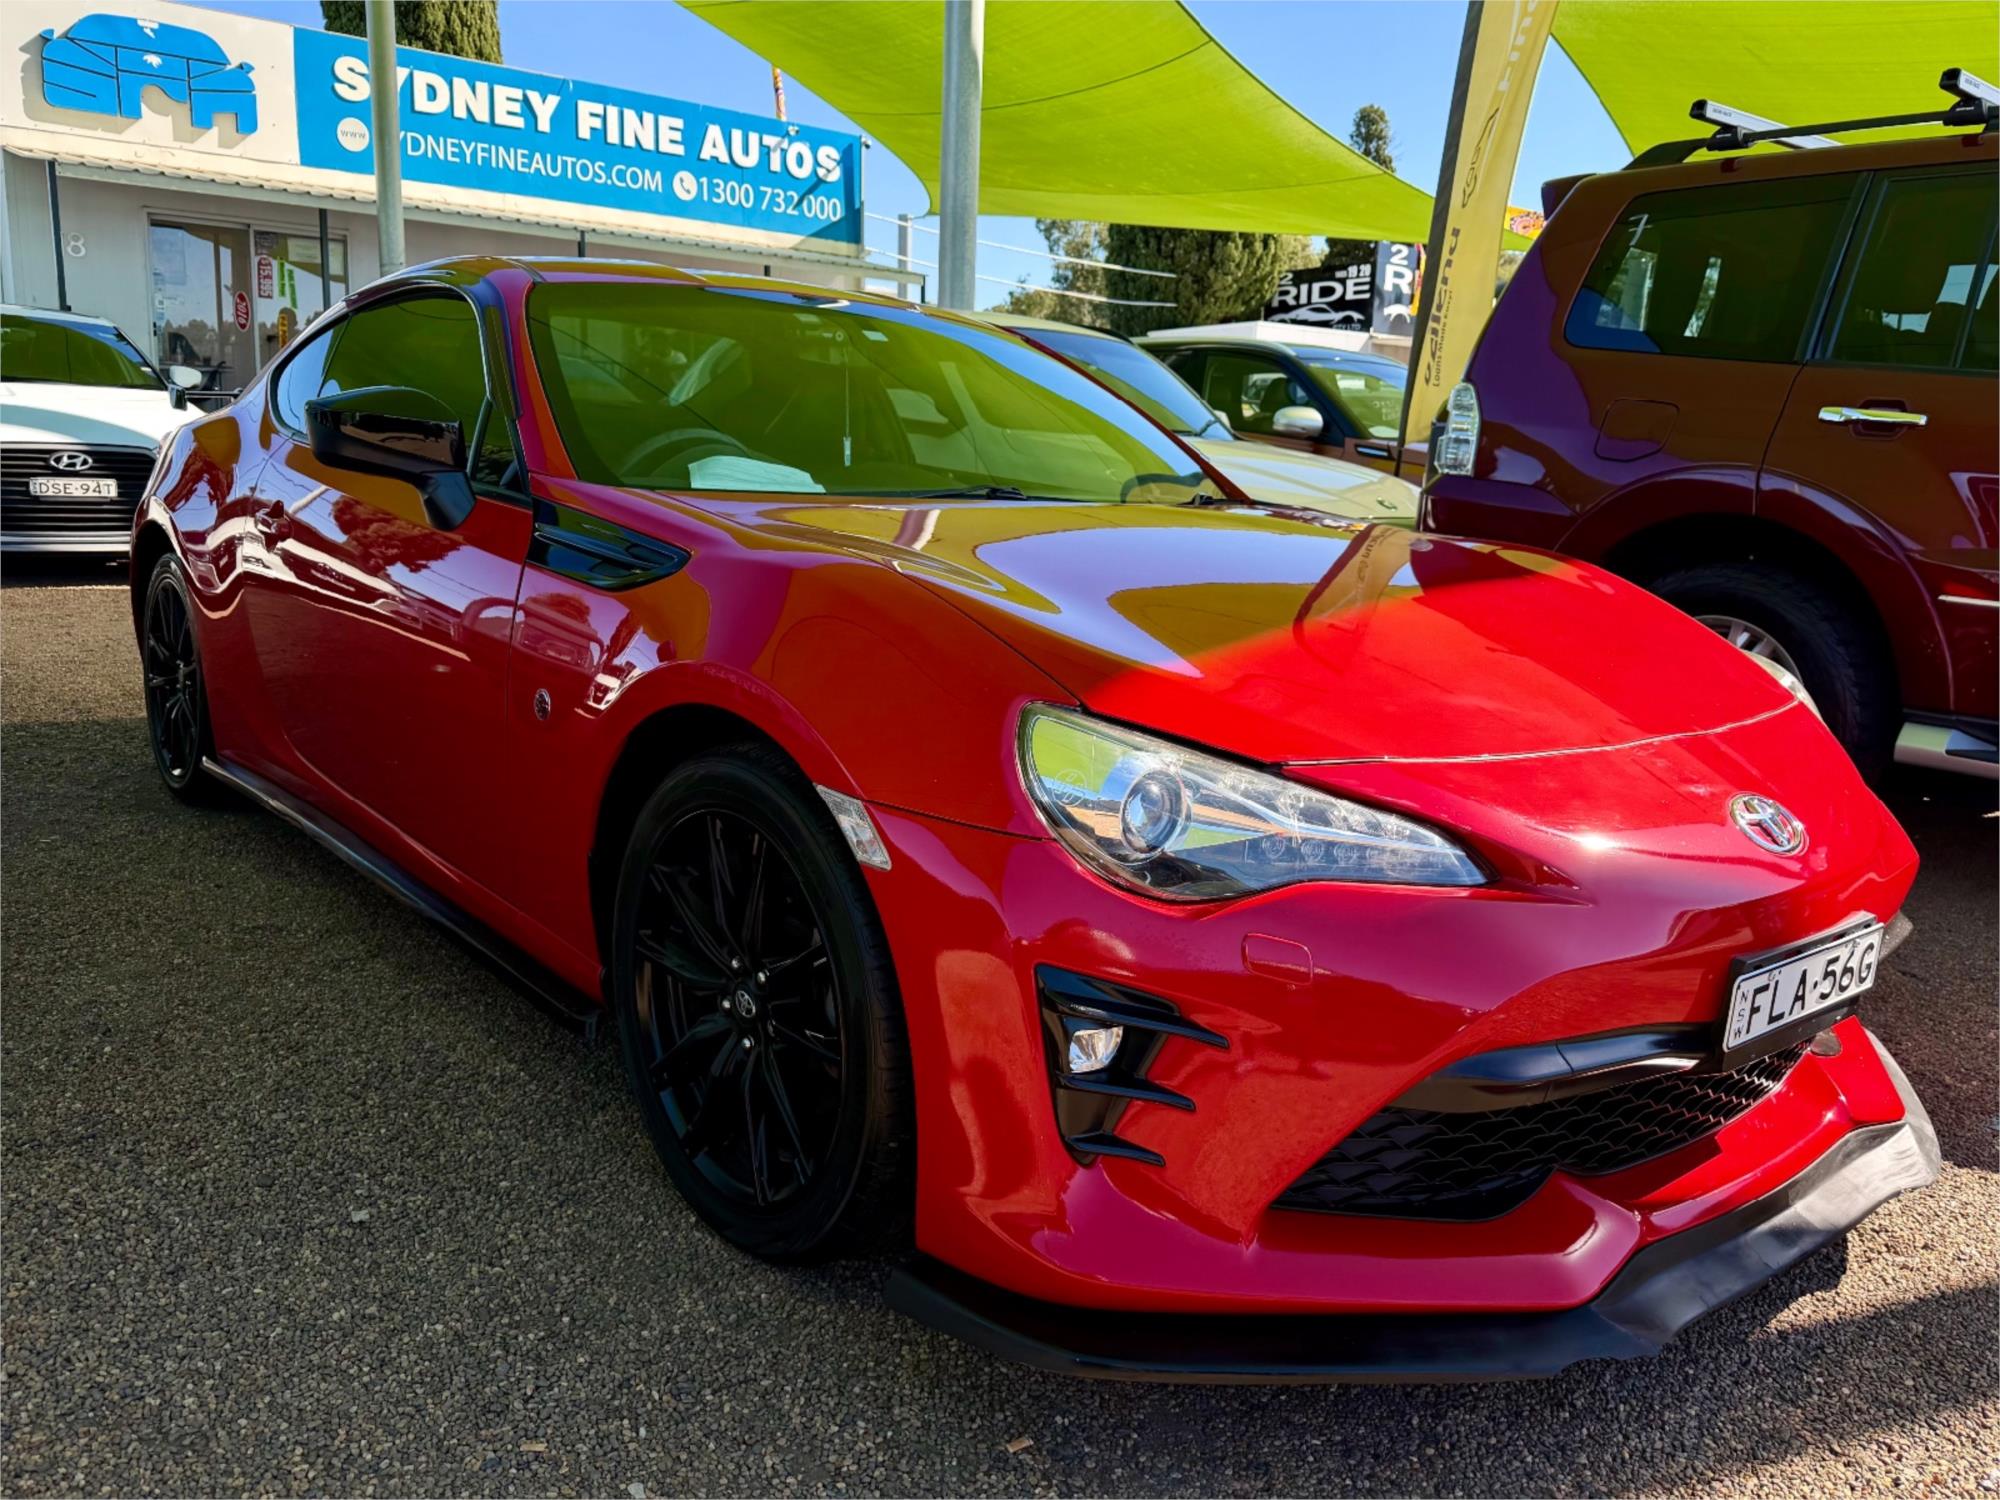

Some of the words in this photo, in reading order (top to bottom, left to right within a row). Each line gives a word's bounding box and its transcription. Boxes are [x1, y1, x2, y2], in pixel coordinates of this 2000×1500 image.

[400, 130, 663, 192] DNEYFINEAUTOS.COM
[577, 99, 686, 156] FINE
[699, 123, 841, 182] AUTOS
[700, 177, 754, 208] 1300
[760, 186, 799, 215] 732
[803, 194, 841, 221] 000
[1271, 277, 1371, 307] RIDE
